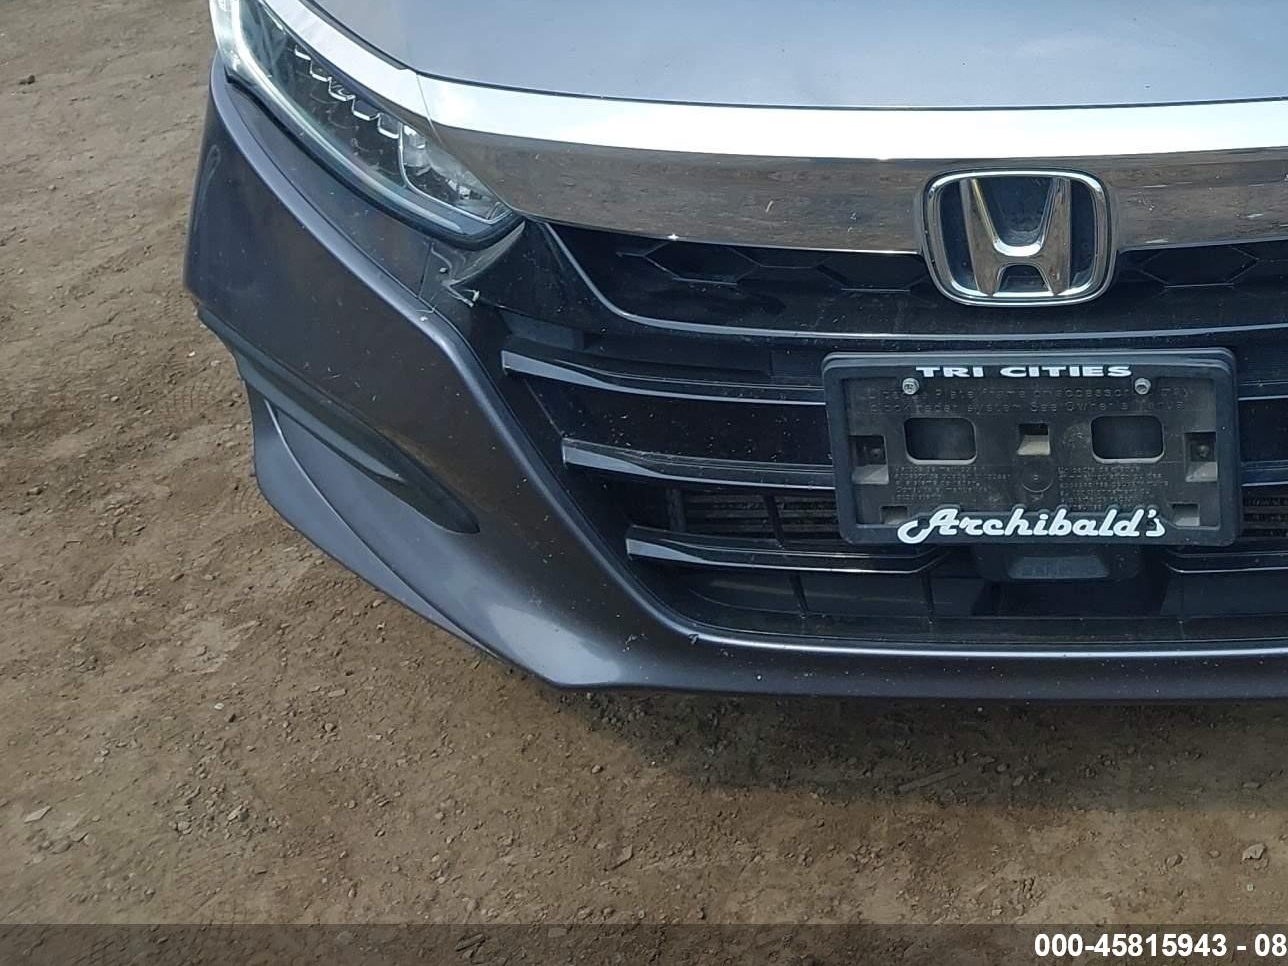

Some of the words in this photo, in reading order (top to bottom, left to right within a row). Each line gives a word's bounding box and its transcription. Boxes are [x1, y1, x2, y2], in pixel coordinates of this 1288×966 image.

[915, 365, 984, 378] TRI
[1000, 365, 1132, 378] CITIES
[897, 508, 1166, 544] Archibald's
